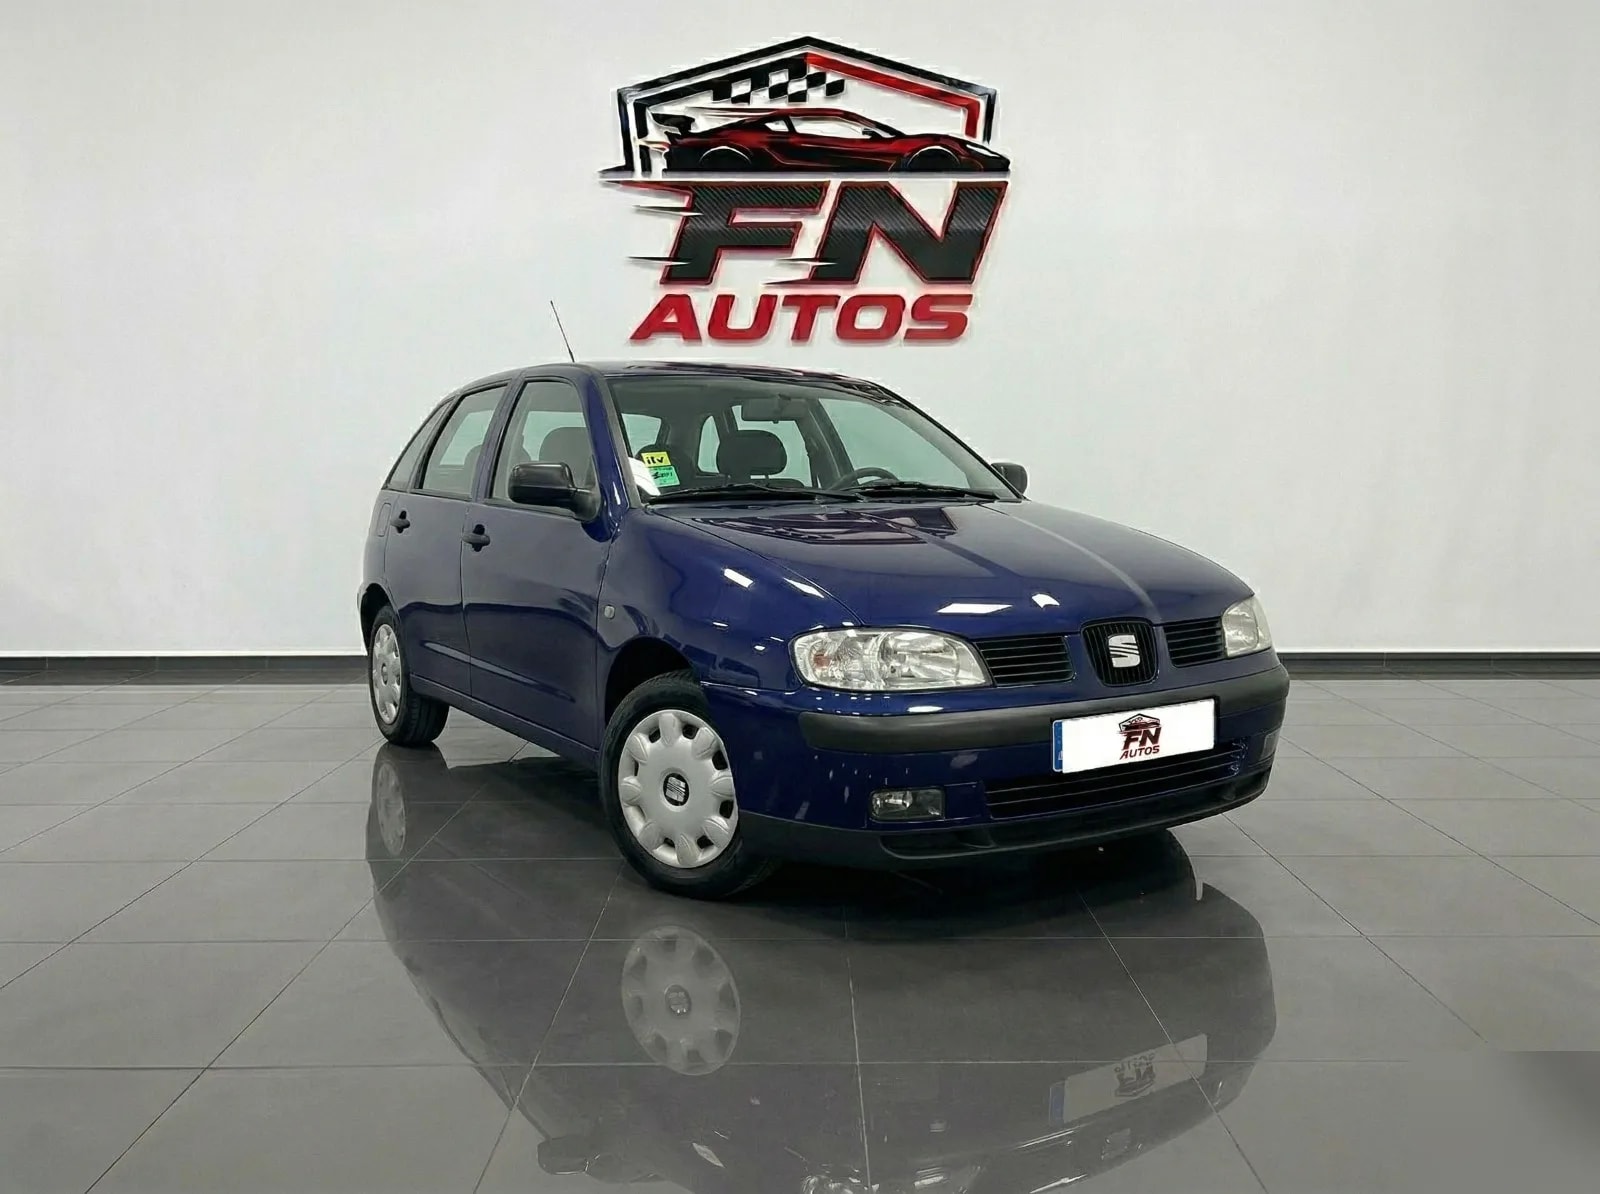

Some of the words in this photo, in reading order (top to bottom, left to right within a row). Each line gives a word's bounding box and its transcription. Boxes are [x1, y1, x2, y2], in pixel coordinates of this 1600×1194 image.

[659, 180, 1009, 286] FN
[629, 294, 974, 342] AUTOS
[1119, 745, 1160, 760] AUTOS
[1122, 727, 1161, 750] FN
